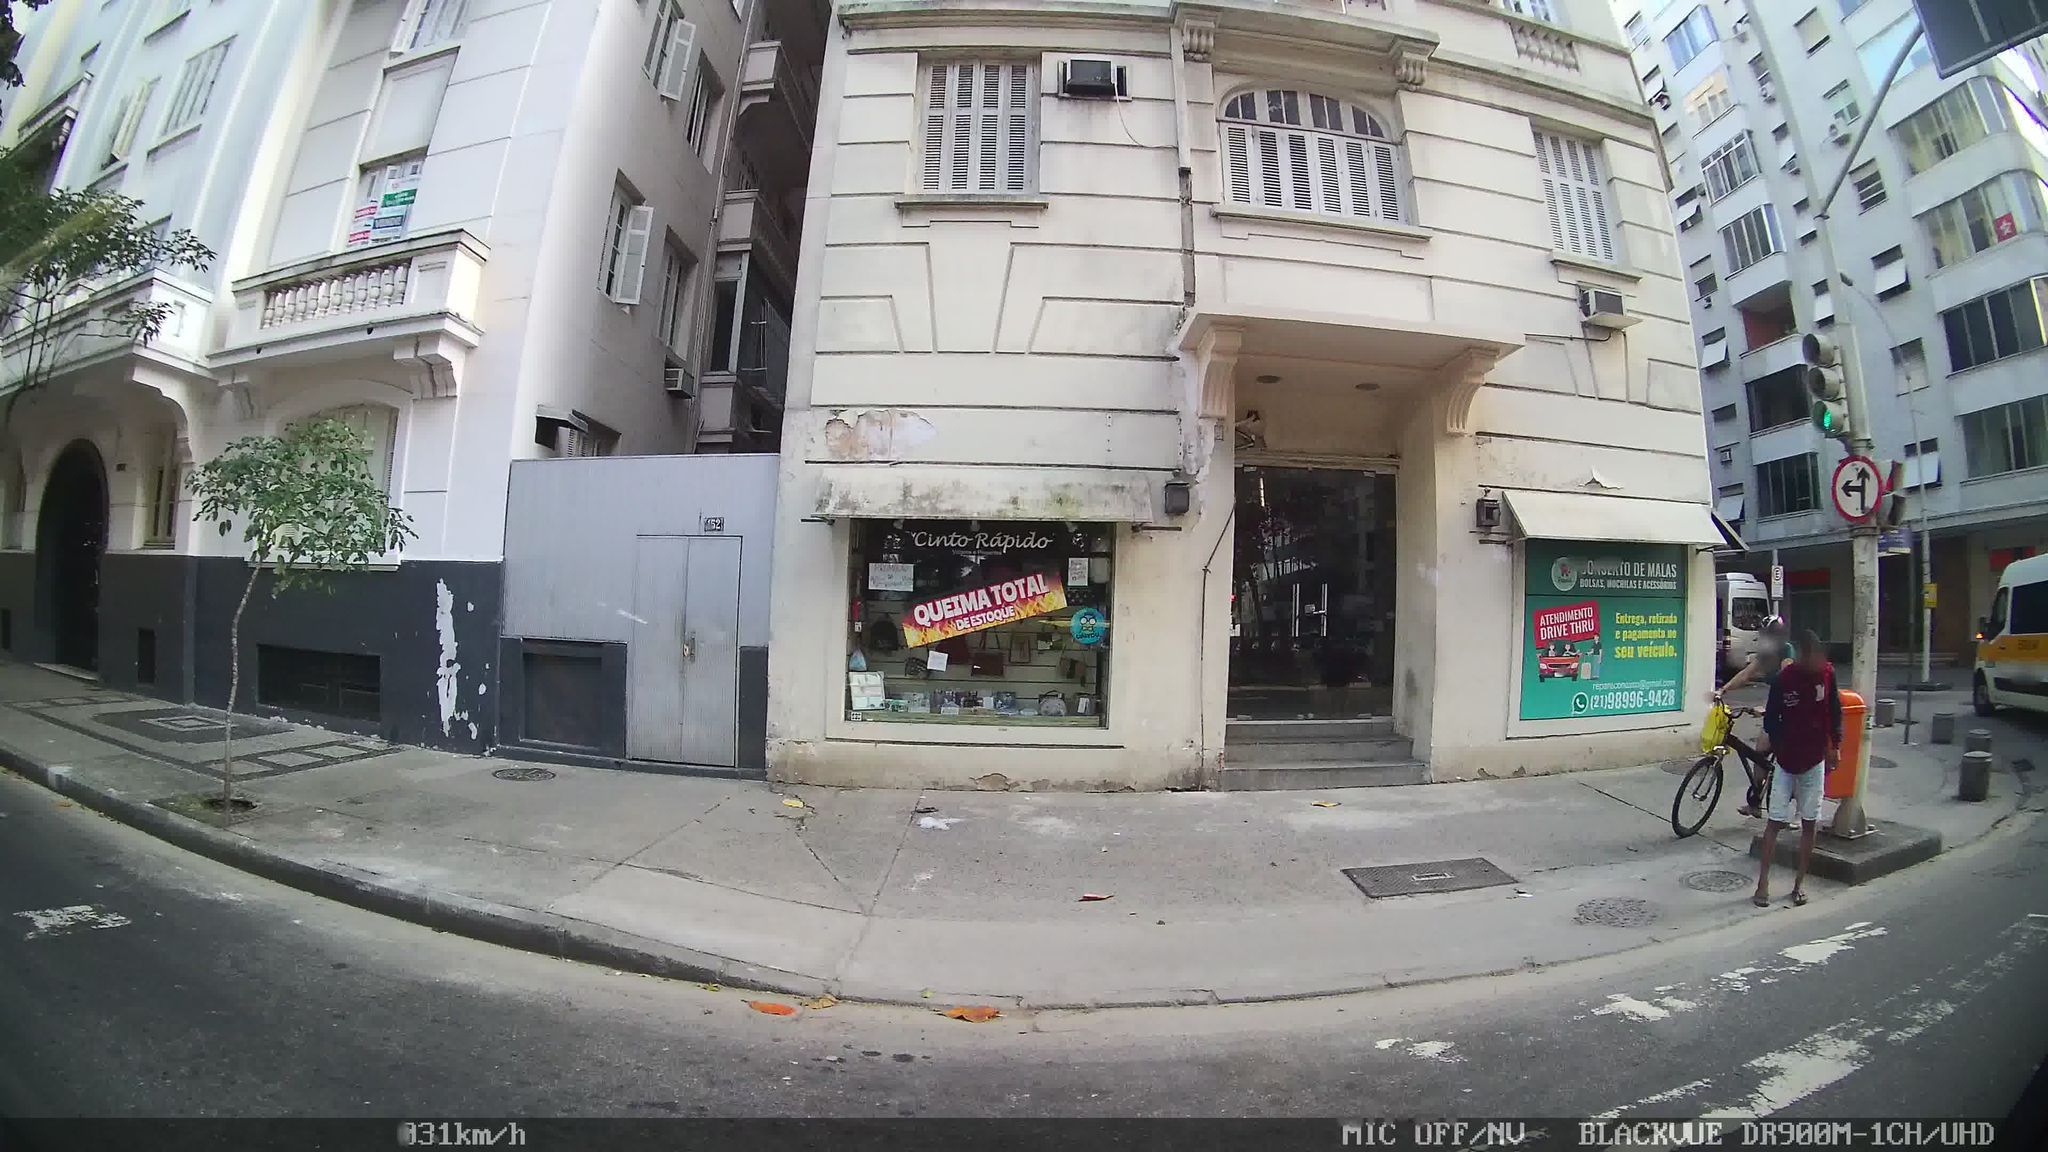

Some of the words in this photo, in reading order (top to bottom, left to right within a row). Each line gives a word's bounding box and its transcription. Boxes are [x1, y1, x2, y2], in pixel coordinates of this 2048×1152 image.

[914, 531, 973, 547] Cinto
[975, 532, 1053, 553] Rápido
[1634, 562, 1645, 577] DE
[1648, 562, 1677, 578] MALAS
[1580, 578, 1606, 590] BOLSAS,
[914, 588, 991, 627] QUEIMA
[991, 574, 1050, 605] TOTAL
[955, 618, 970, 631] DE
[970, 606, 1016, 625] ESTOQUE
[1540, 606, 1593, 626] ATENDIMENTO
[1615, 612, 1646, 626] Entrega,
[1648, 612, 1677, 624] retirada
[1540, 623, 1568, 640] DRIVE
[1570, 619, 1595, 635] THRU
[1615, 630, 1621, 639] e
[1622, 628, 1665, 641] pagamento
[1667, 629, 1677, 639] no
[1614, 646, 1635, 658] seu
[1637, 641, 1677, 658] veículo.
